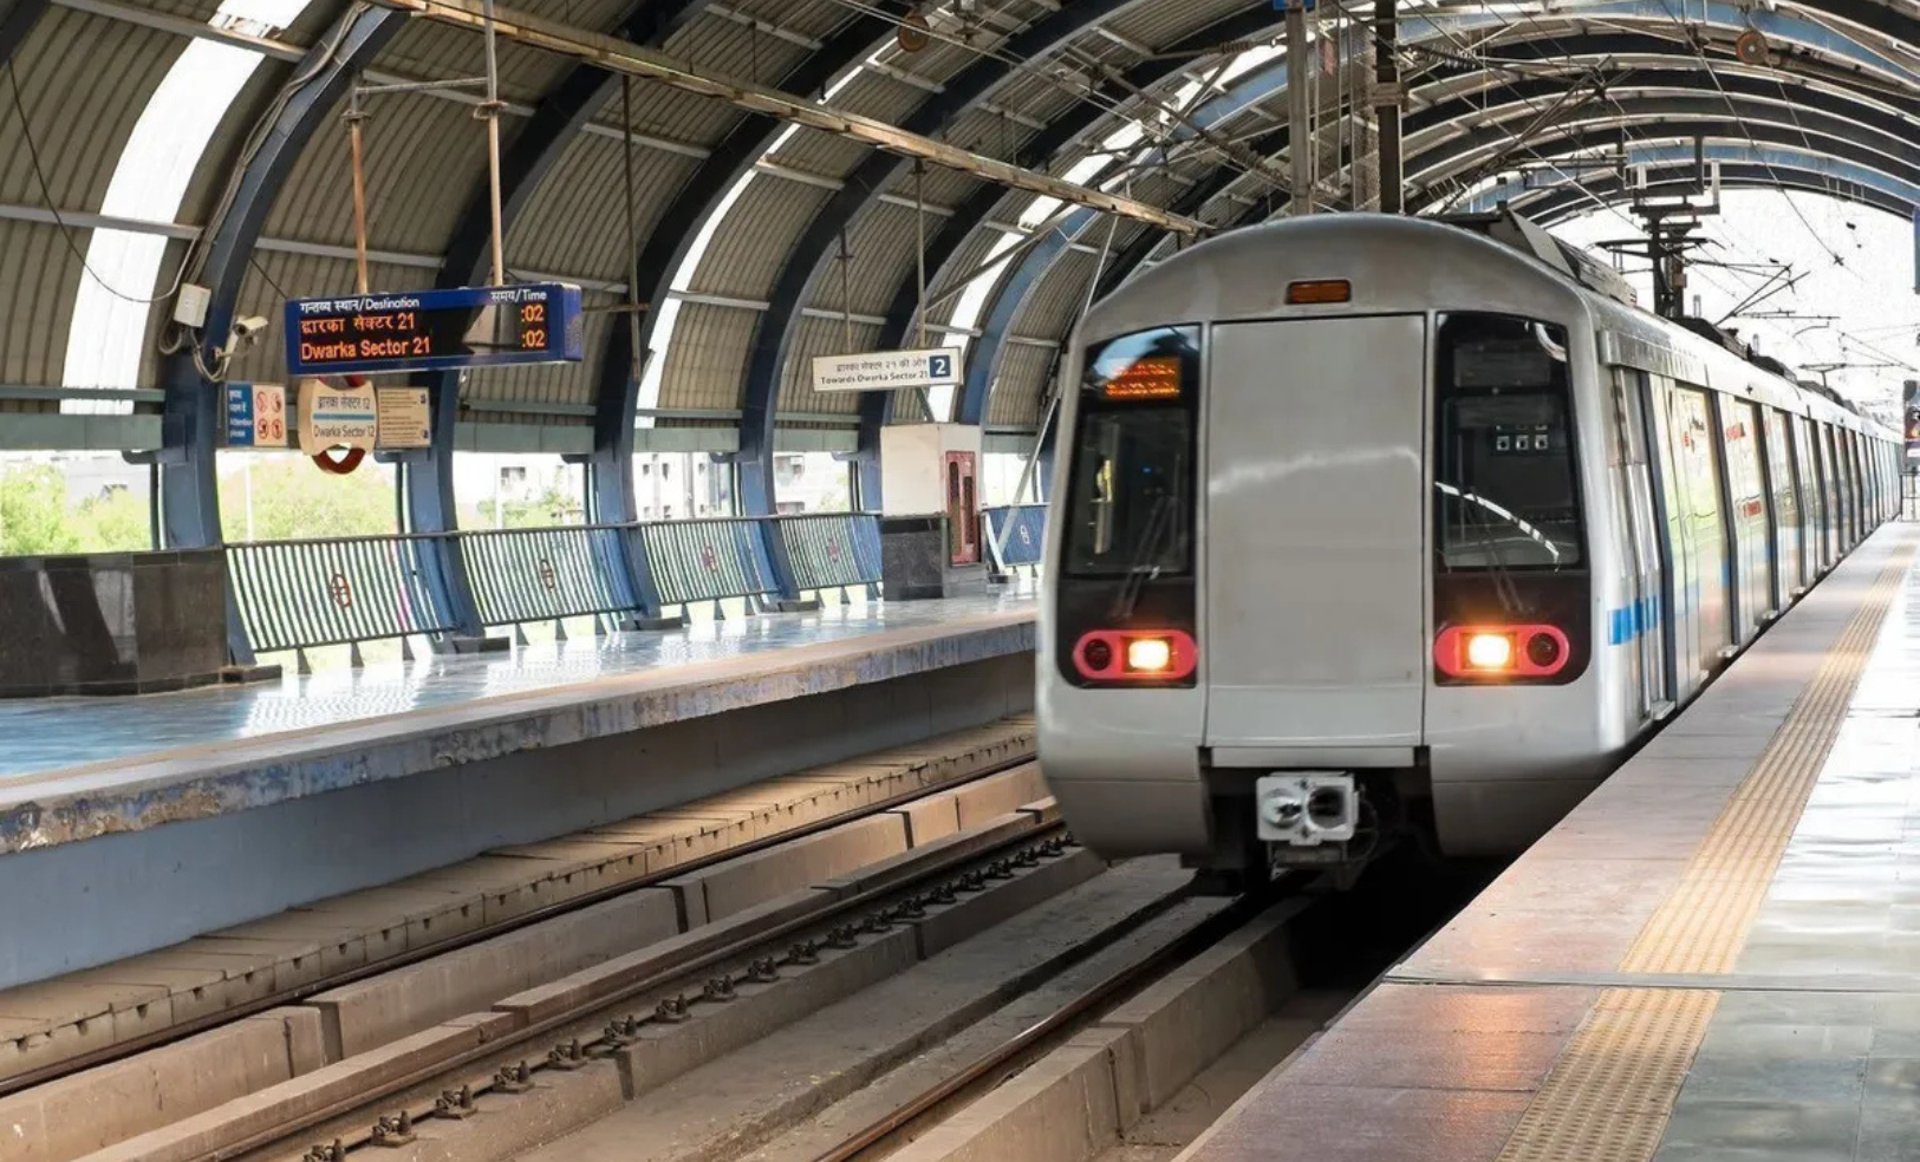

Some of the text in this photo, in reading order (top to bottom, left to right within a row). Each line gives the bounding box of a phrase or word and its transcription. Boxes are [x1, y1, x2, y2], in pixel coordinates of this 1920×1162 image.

[491, 288, 547, 303] समय/Time
[300, 302, 331, 313] गन्तव्य
[521, 304, 544, 322] :02
[354, 311, 393, 333] सेक्टर
[398, 313, 415, 330] 21
[521, 330, 545, 348] :02
[301, 336, 430, 361] Dwarka Sector 21
[935, 359, 946, 375] 2
[821, 370, 928, 384] Towards Dwarka Sector 21
[362, 397, 371, 410] 12
[314, 425, 341, 438] Dwarka
[342, 424, 365, 438] Sector
[366, 425, 375, 438] 12
